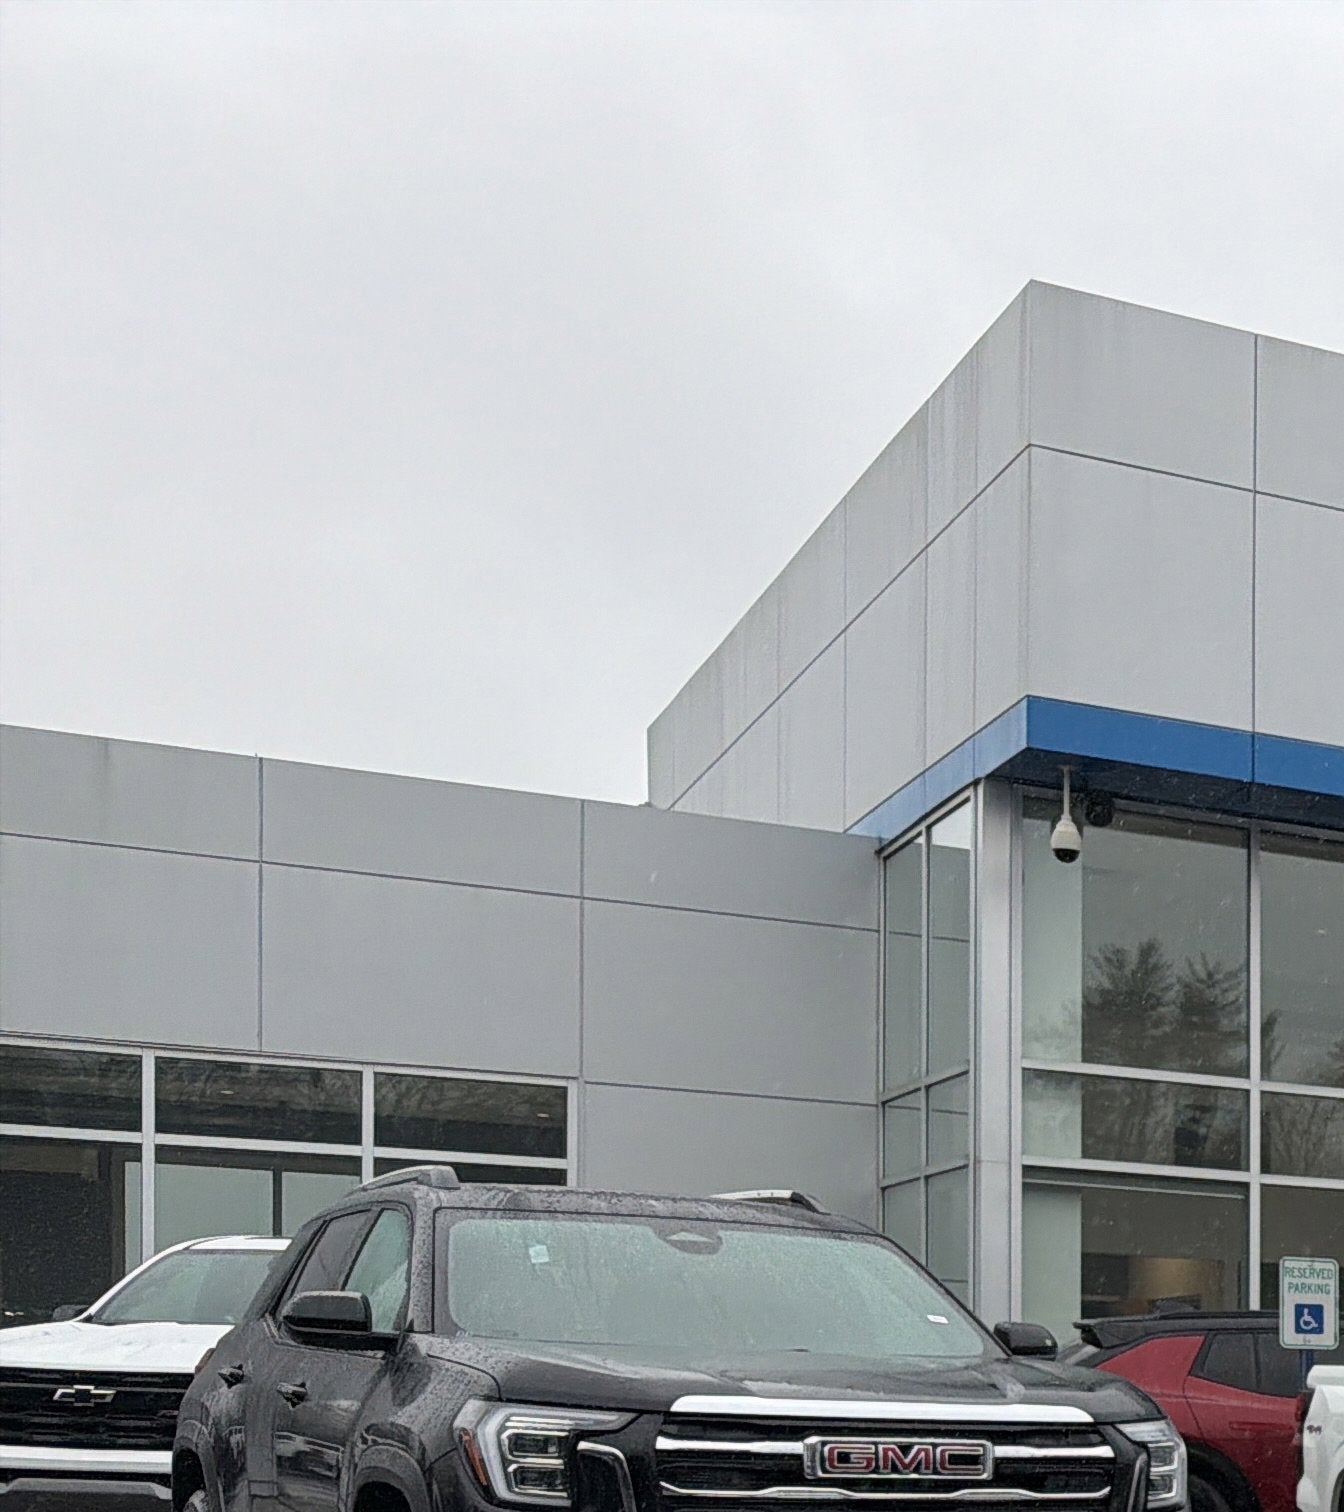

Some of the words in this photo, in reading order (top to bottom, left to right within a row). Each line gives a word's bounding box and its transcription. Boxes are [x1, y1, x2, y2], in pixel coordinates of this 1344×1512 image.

[1284, 1266, 1334, 1280] RESERVED
[1287, 1281, 1331, 1295] PARKING
[823, 1442, 984, 1474] GMC
